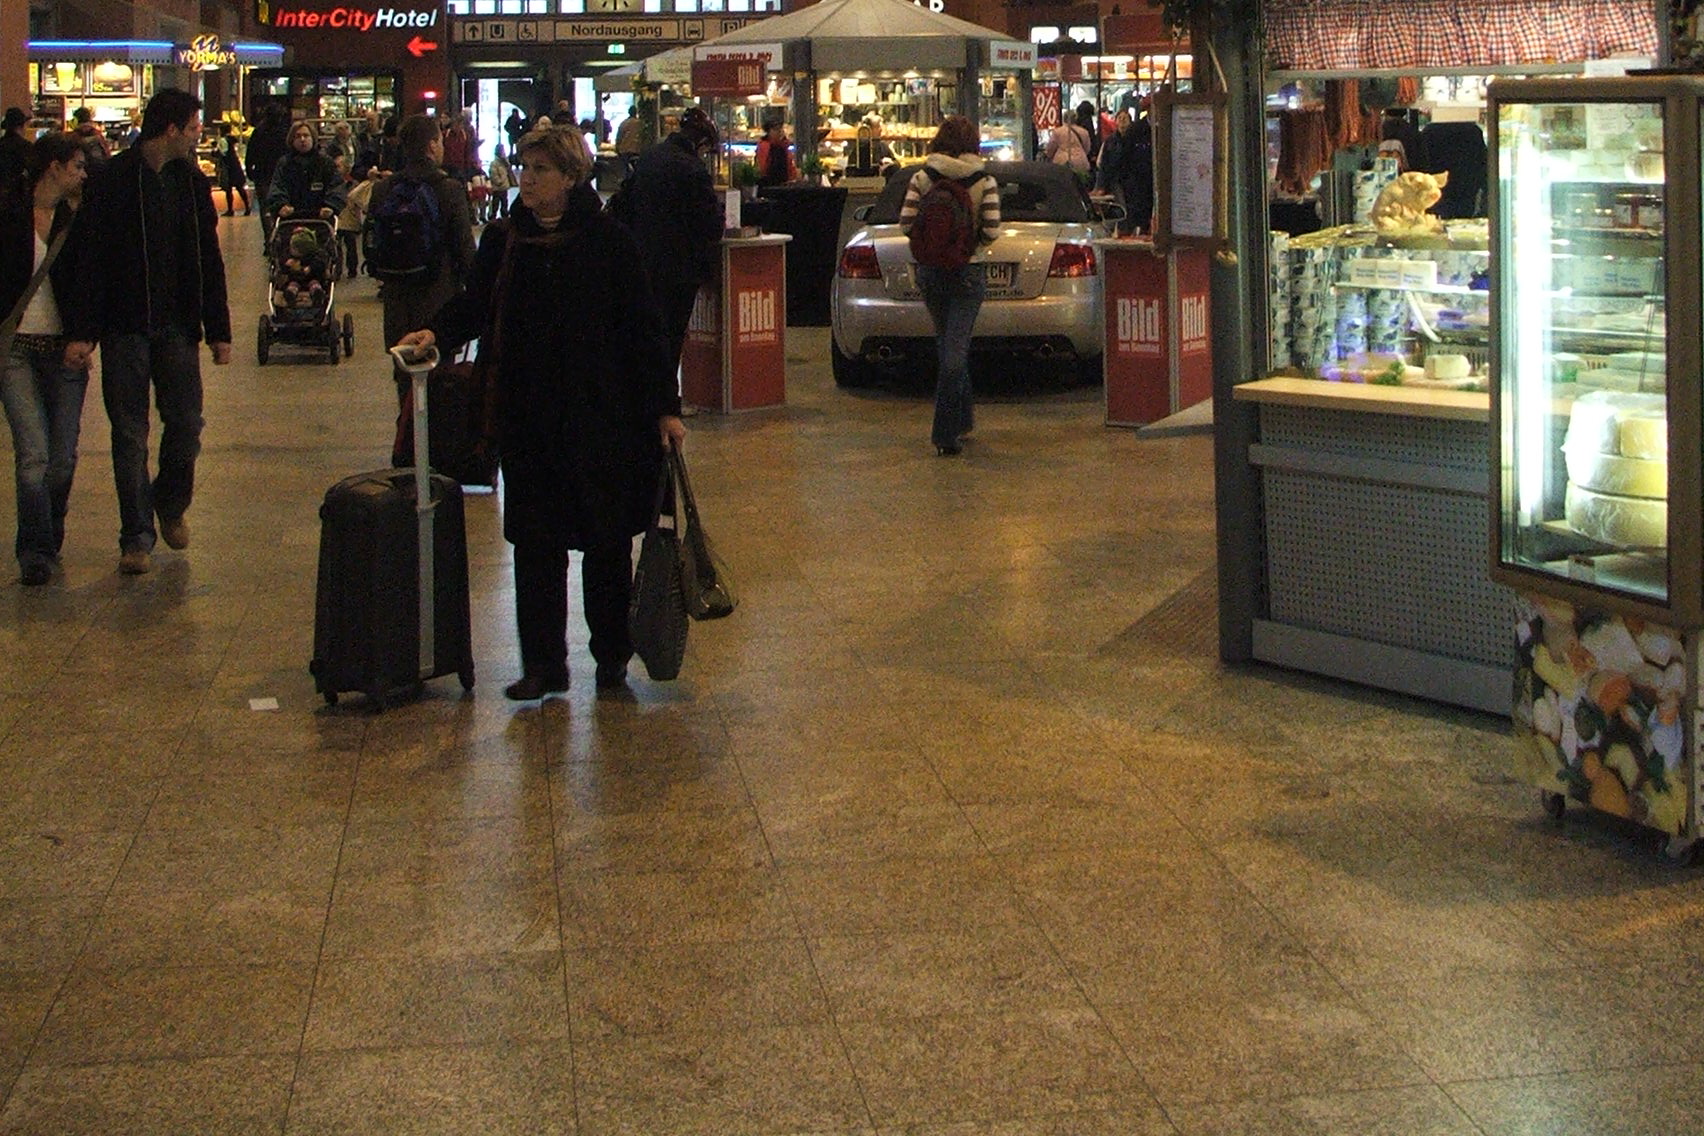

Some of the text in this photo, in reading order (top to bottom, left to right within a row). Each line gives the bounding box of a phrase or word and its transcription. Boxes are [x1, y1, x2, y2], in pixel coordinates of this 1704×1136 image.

[275, 8, 438, 31] InterCityHotel
[571, 23, 663, 38] Nordausgang
[180, 50, 236, 64] YORMA'S
[738, 291, 775, 332] Bild
[1117, 297, 1160, 342] Bild
[1181, 294, 1206, 341] Bild
